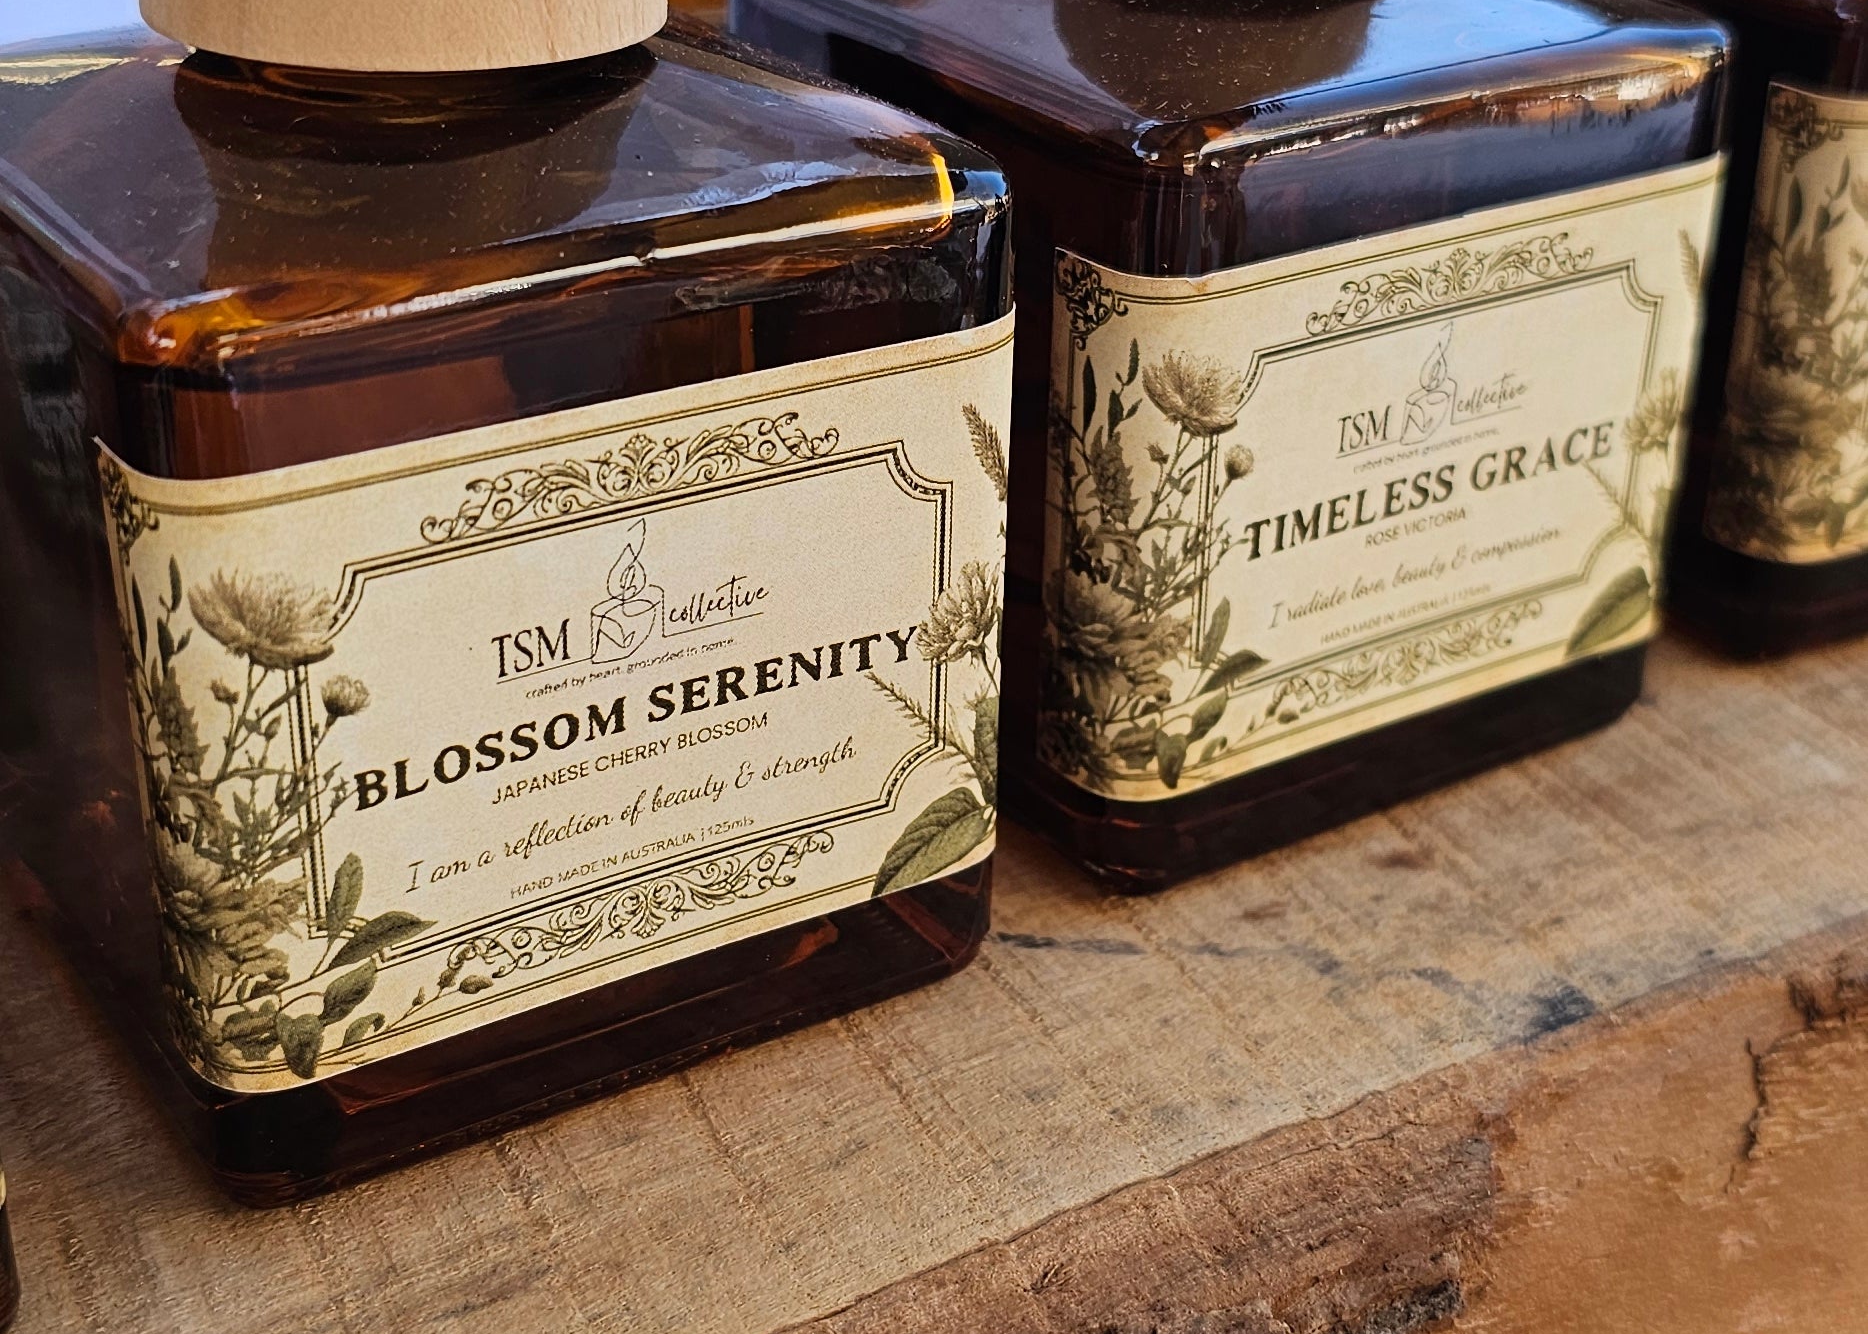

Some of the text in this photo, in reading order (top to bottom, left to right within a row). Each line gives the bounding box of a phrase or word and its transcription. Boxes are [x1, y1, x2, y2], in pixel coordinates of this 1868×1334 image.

[1337, 404, 1391, 453] TSM
[1246, 464, 1455, 562] TIMELESS
[1469, 420, 1614, 491] GRACE
[1364, 507, 1466, 548] ROSE VICTORIA
[491, 575, 770, 679] TSM collective
[1268, 601, 1284, 630] I
[1287, 586, 1347, 621] radiate
[1392, 553, 1446, 588] beauty
[354, 624, 919, 811] BLOSSOM SERENITY
[525, 678, 568, 700] crafted
[571, 675, 587, 688] by
[491, 712, 768, 805] JAPANESE CHERRY BLOSSOM
[405, 735, 856, 894] I am a reflection of beauty & strength
[510, 876, 554, 899] HAND
[558, 860, 598, 883] MADE
[601, 854, 618, 869] IN
[621, 831, 696, 864] AUSTRALIA
